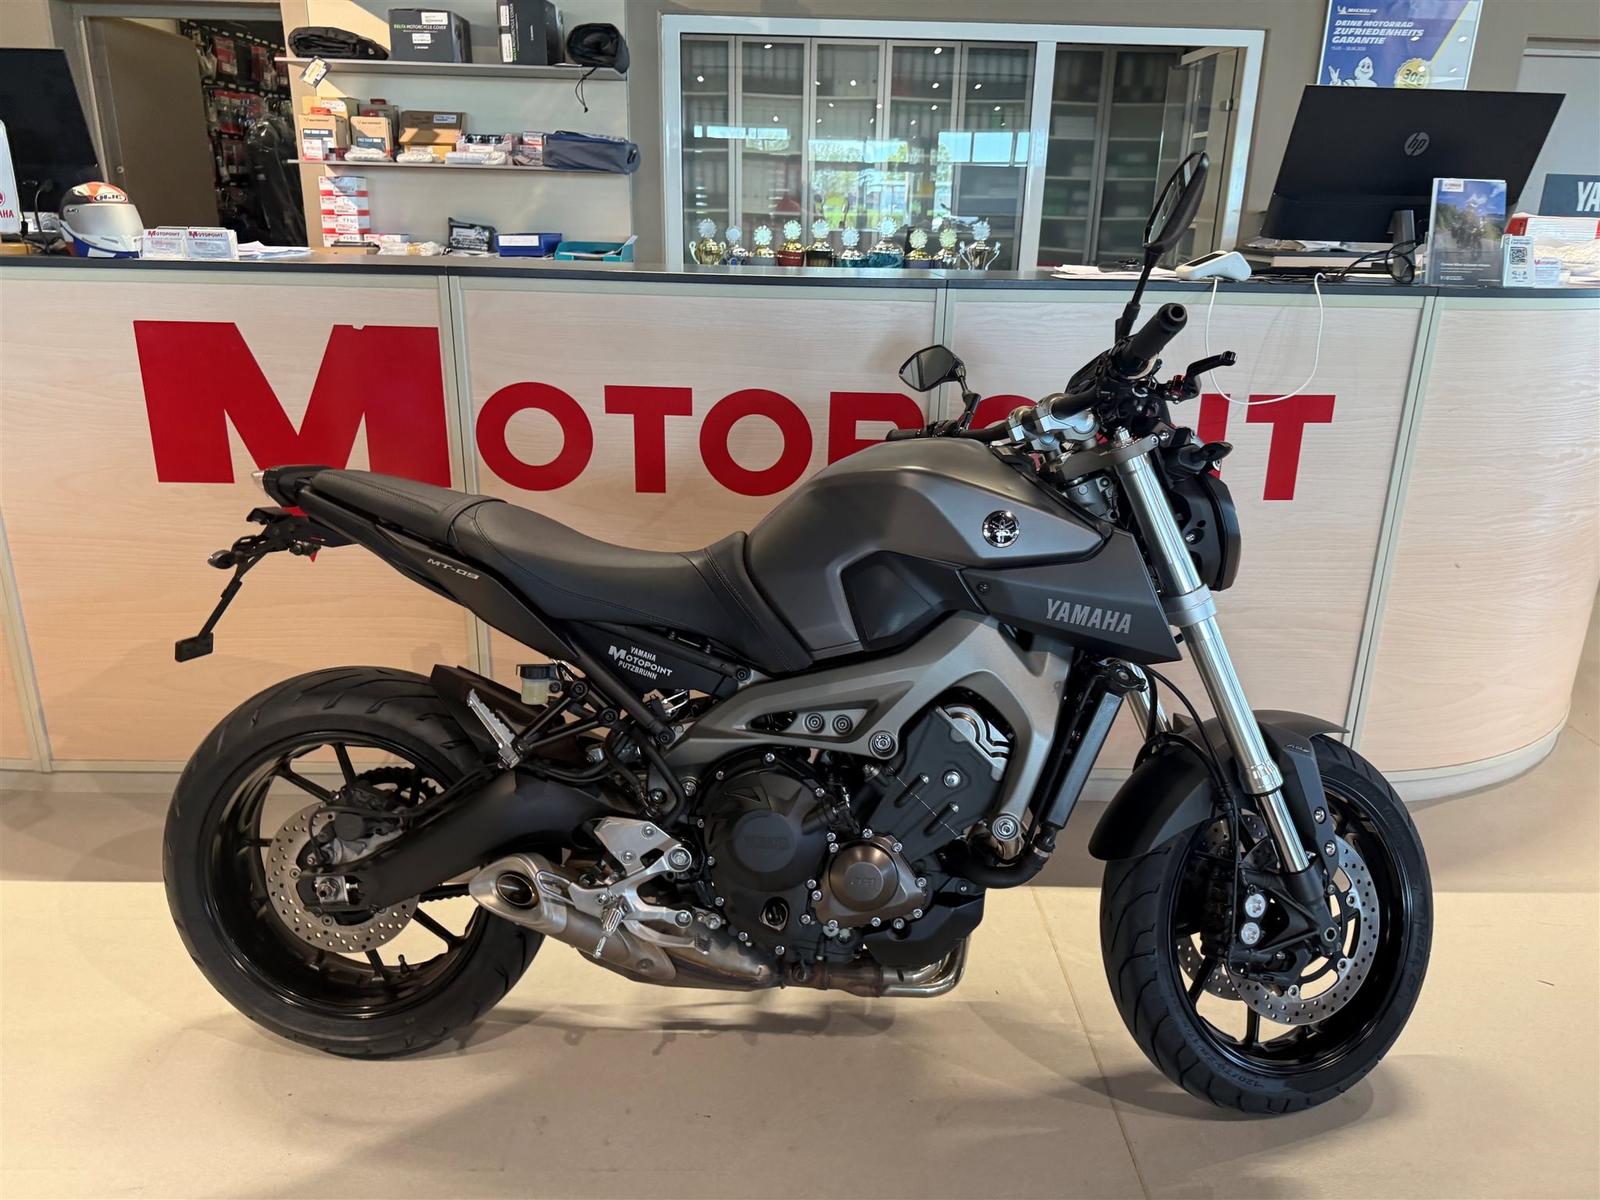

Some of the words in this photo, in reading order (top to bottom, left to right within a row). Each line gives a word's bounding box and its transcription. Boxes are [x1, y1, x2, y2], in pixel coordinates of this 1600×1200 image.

[1363, 20, 1414, 28] MOTORRAD
[1333, 27, 1425, 37] ZUFRIEDENHEITS
[1332, 36, 1387, 44] GARANTIE
[147, 230, 180, 238] MOTOPOINT
[188, 230, 223, 238] MOTOPOINT
[426, 558, 480, 580] MT-09
[1046, 598, 1133, 634] YAMAHA
[608, 645, 673, 677] MOTOPOINT
[630, 645, 657, 663] YAMAHA
[617, 660, 658, 680] PUTZBRUNN
